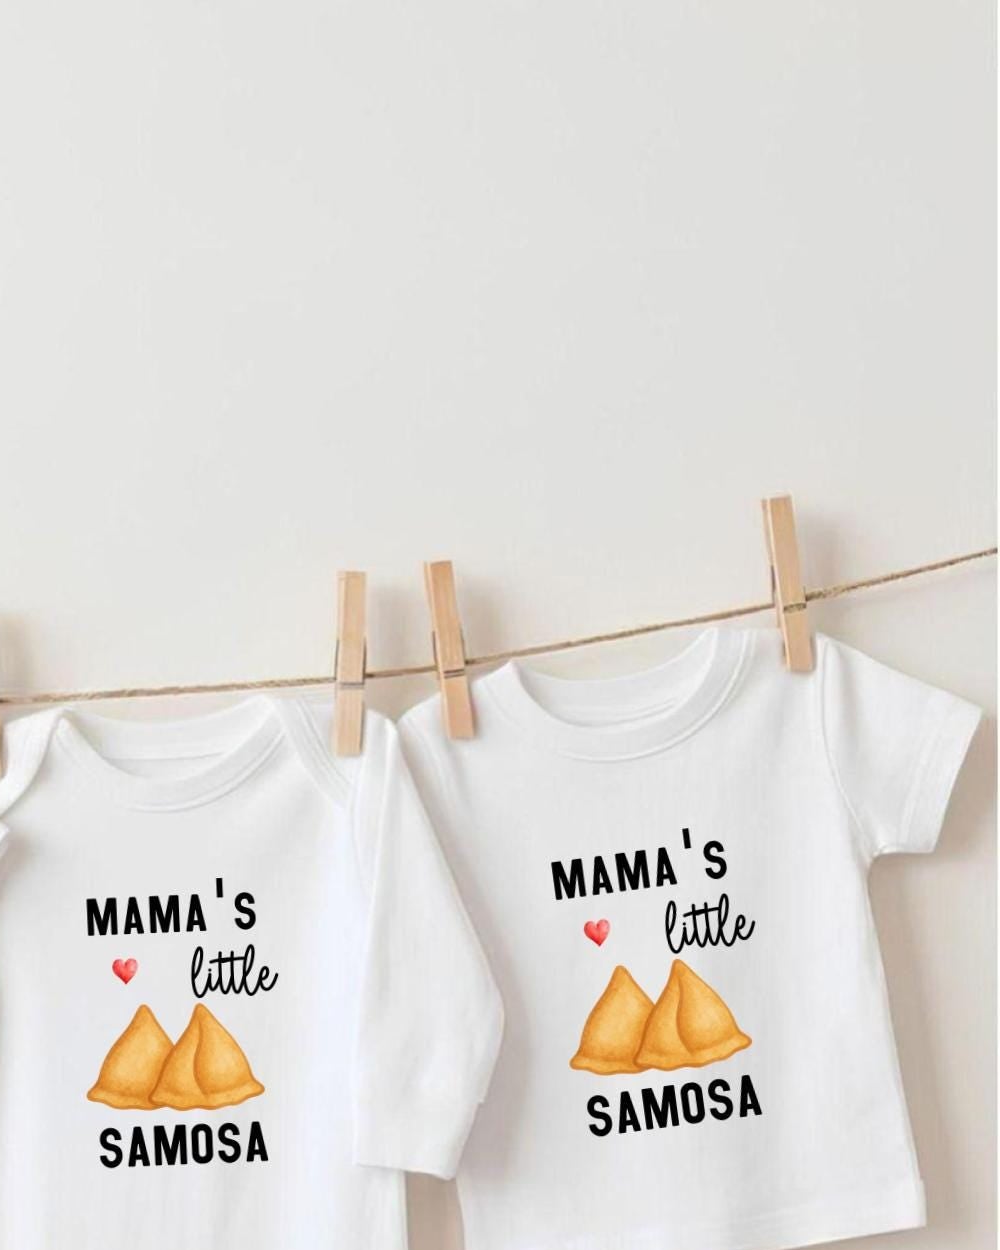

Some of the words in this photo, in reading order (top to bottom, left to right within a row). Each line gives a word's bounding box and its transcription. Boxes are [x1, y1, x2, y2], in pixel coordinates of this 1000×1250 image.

[551, 828, 728, 901] MAMA'S
[86, 878, 256, 936] MAMA'S
[665, 893, 755, 954] little
[191, 944, 278, 998] little
[587, 1075, 762, 1137] SAMOSA
[100, 1121, 268, 1168] SAMOSA
